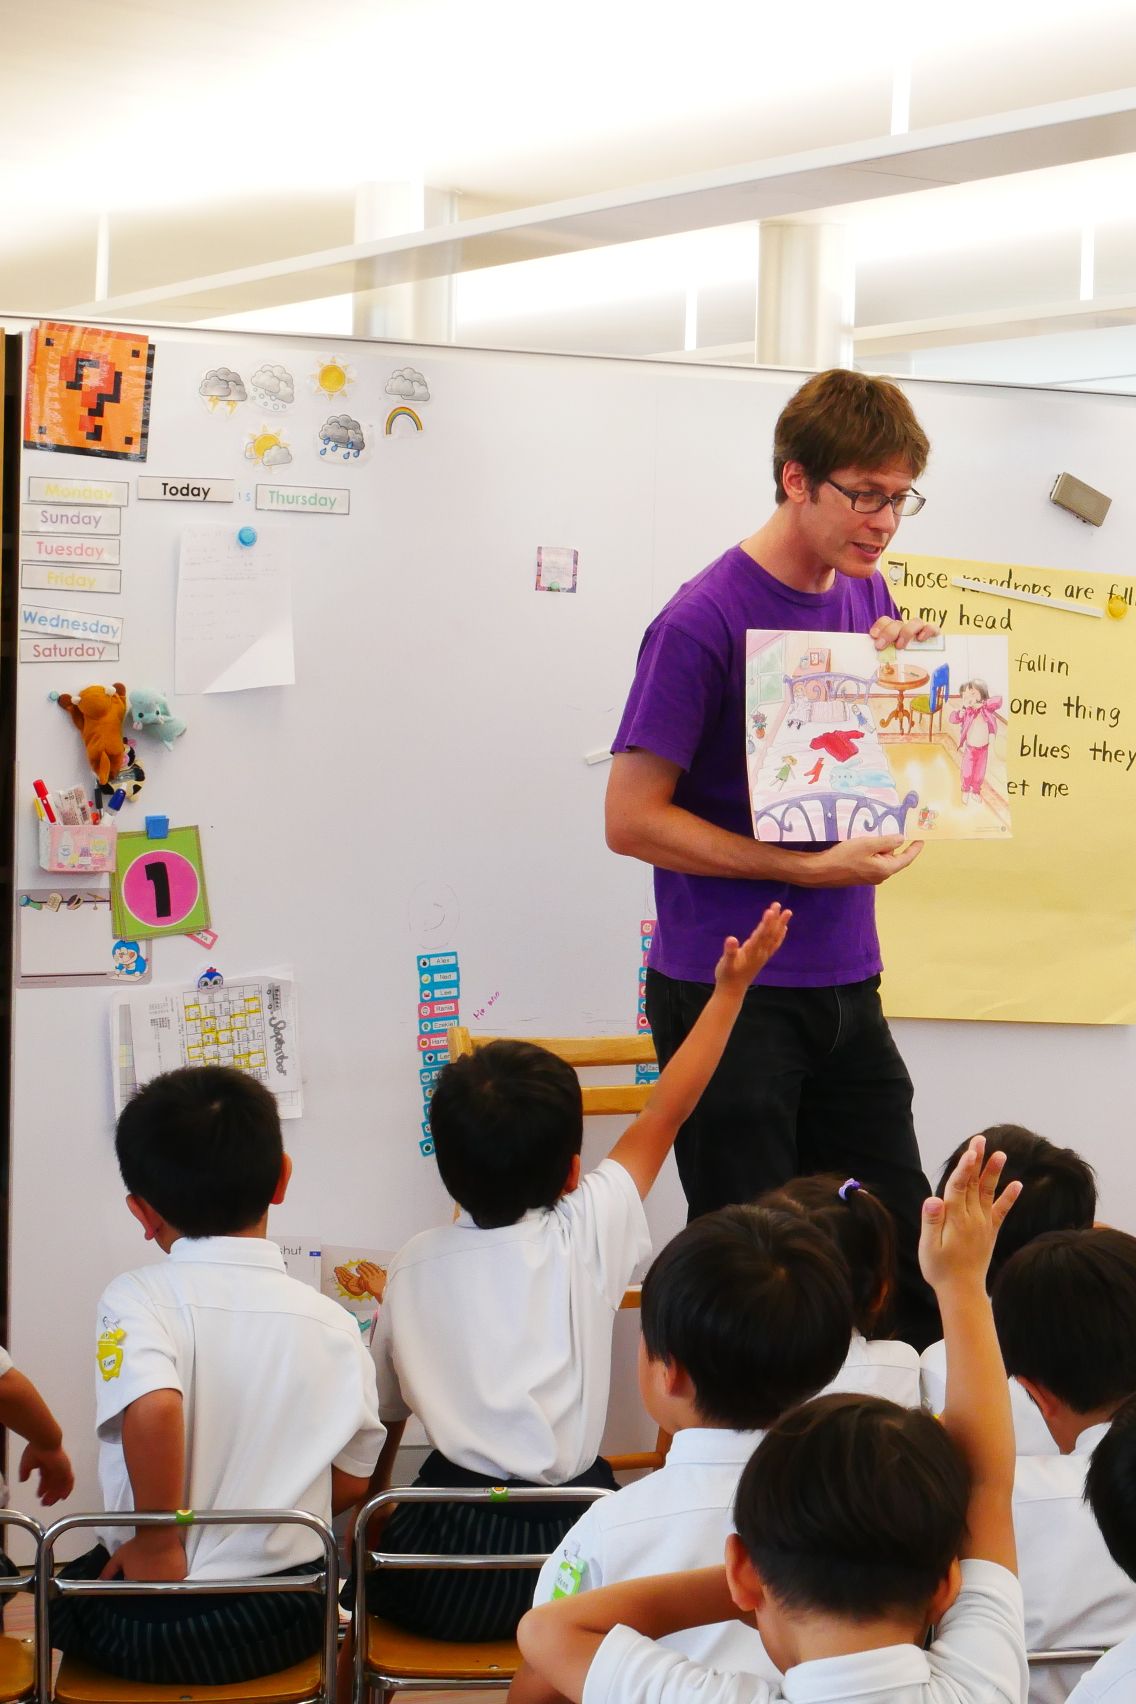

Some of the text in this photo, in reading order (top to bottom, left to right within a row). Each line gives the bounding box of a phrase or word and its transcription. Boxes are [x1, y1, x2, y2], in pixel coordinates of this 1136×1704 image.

[44, 484, 113, 501] Monday
[162, 482, 211, 501] Today
[268, 490, 337, 510] Thursday
[40, 510, 102, 529] Sunday
[36, 541, 104, 560] Tuesday
[47, 571, 97, 589] Friday
[961, 567, 1053, 598] rndrops
[1064, 583, 1095, 600] are
[22, 609, 120, 637] Wednesday
[918, 605, 948, 629] my
[959, 603, 1013, 632] head
[32, 643, 106, 661] Saturday
[1014, 652, 1070, 677] fallin
[1010, 695, 1121, 729] one thing
[1019, 733, 1071, 760] blues
[1041, 780, 1070, 799] me
[144, 860, 172, 918] 1
